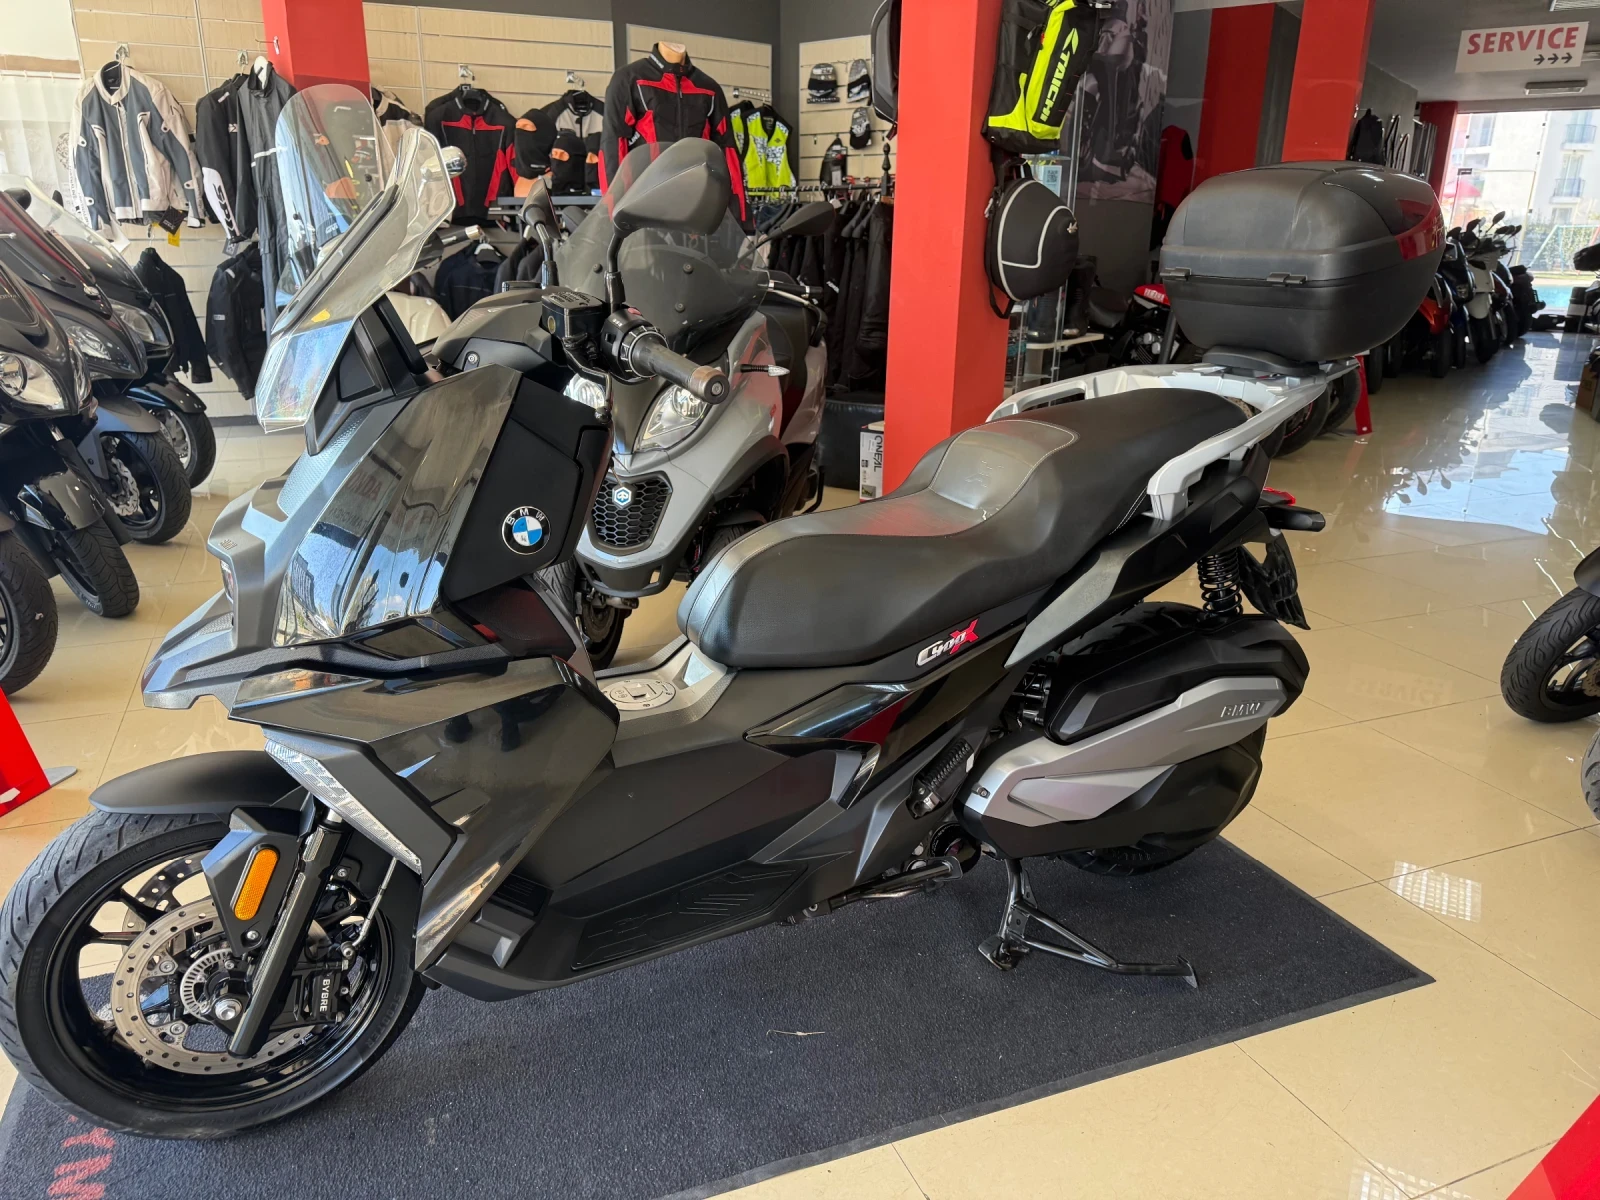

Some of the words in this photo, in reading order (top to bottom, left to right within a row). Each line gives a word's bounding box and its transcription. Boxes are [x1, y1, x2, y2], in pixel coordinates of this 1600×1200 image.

[1467, 26, 1580, 55] SERVICE
[1040, 50, 1070, 122] TAICHI
[505, 506, 545, 526] BMW
[1220, 702, 1261, 718] BMW
[319, 978, 331, 1013] BYBRE
